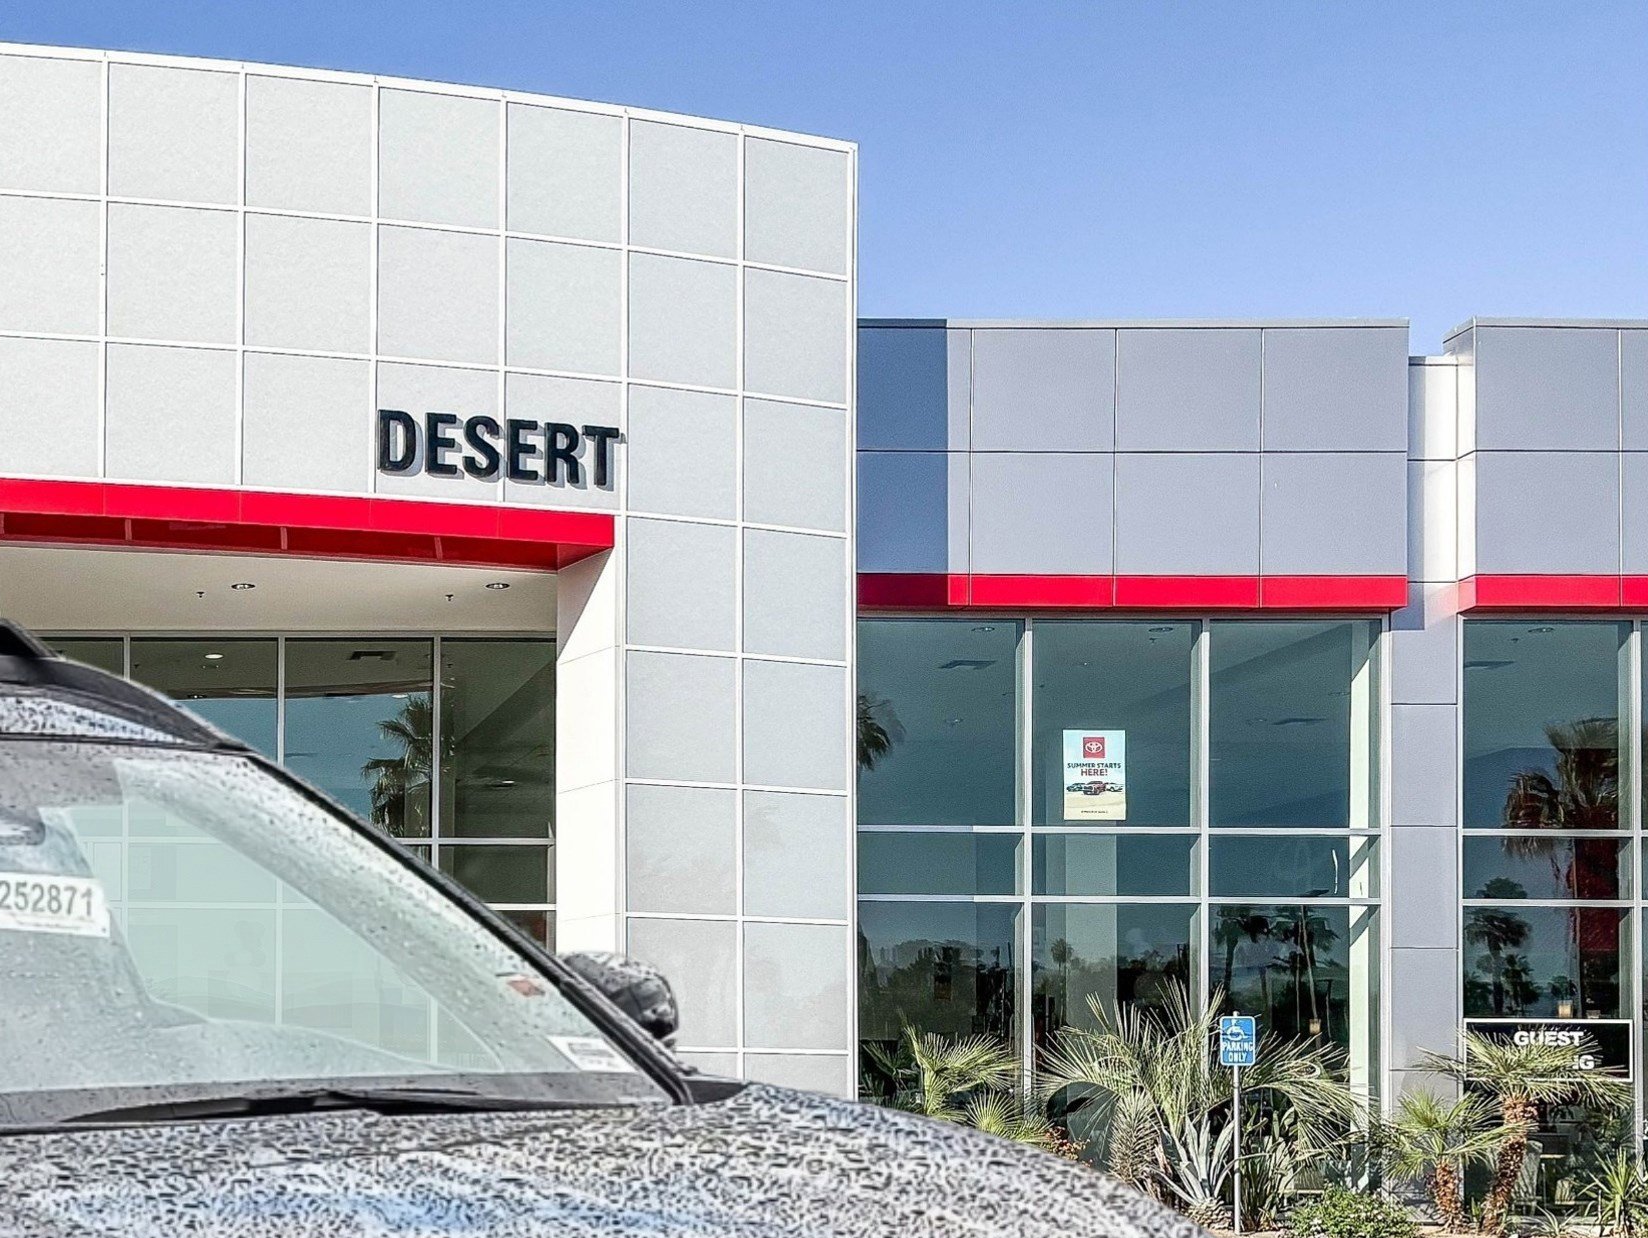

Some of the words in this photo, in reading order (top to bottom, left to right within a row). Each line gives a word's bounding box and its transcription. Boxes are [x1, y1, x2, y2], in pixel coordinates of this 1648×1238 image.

[377, 409, 620, 487] DESERT
[1081, 768, 1108, 776] HERE!
[1513, 1030, 1584, 1047] GUEST
[1222, 1041, 1253, 1052] PARKING
[1228, 1051, 1248, 1062] ONLY
